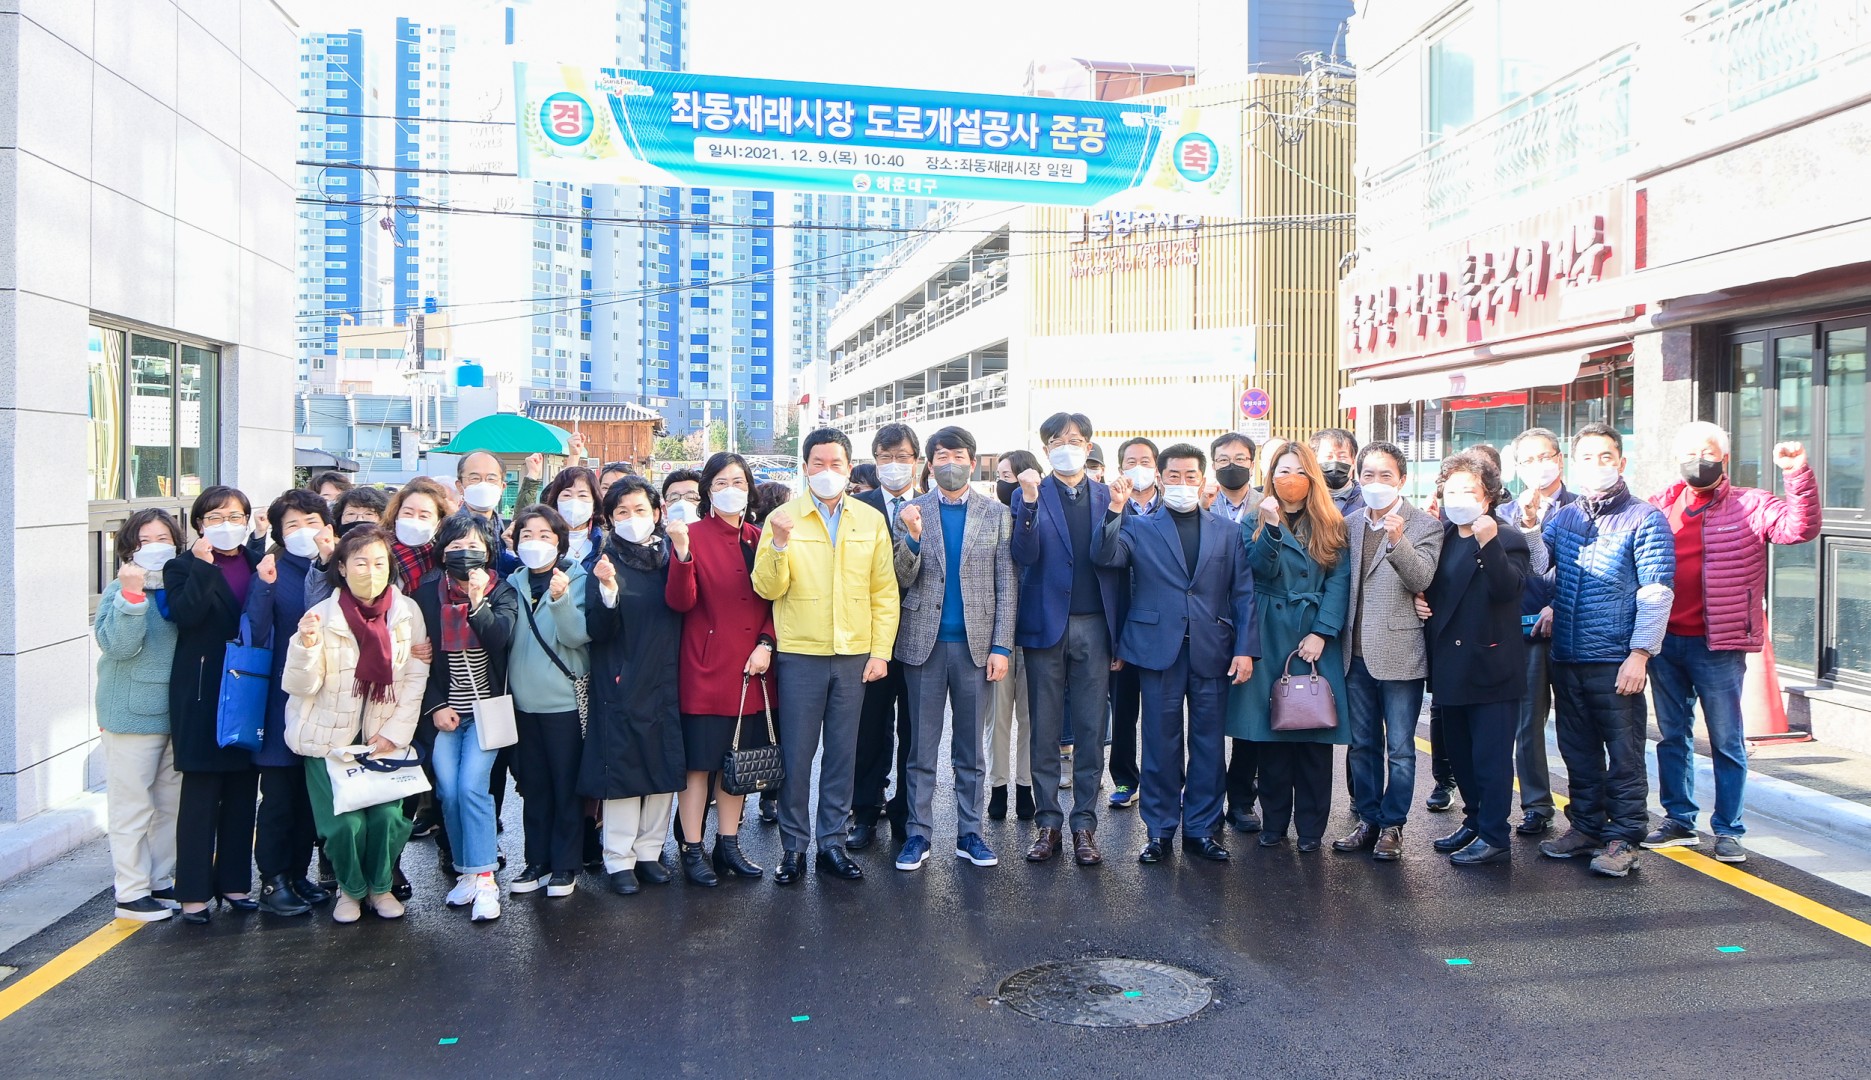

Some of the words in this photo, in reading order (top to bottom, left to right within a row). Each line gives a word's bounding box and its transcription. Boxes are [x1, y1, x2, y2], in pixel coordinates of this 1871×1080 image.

[551, 103, 581, 135] 경
[670, 90, 855, 138] 좌동재래시장
[863, 104, 1040, 149] 도로개설공사
[1049, 115, 1106, 153] 준공
[708, 144, 784, 160] 일시:2021.
[791, 149, 813, 162] 12.
[818, 149, 857, 165] 9.(목)
[864, 153, 904, 167] 10:40
[926, 156, 1041, 176] 장소:좌동재래시장
[1047, 162, 1073, 178] 일원
[1182, 139, 1210, 174] 축
[875, 176, 938, 194] 해운대구
[1152, 249, 1201, 269] Parking
